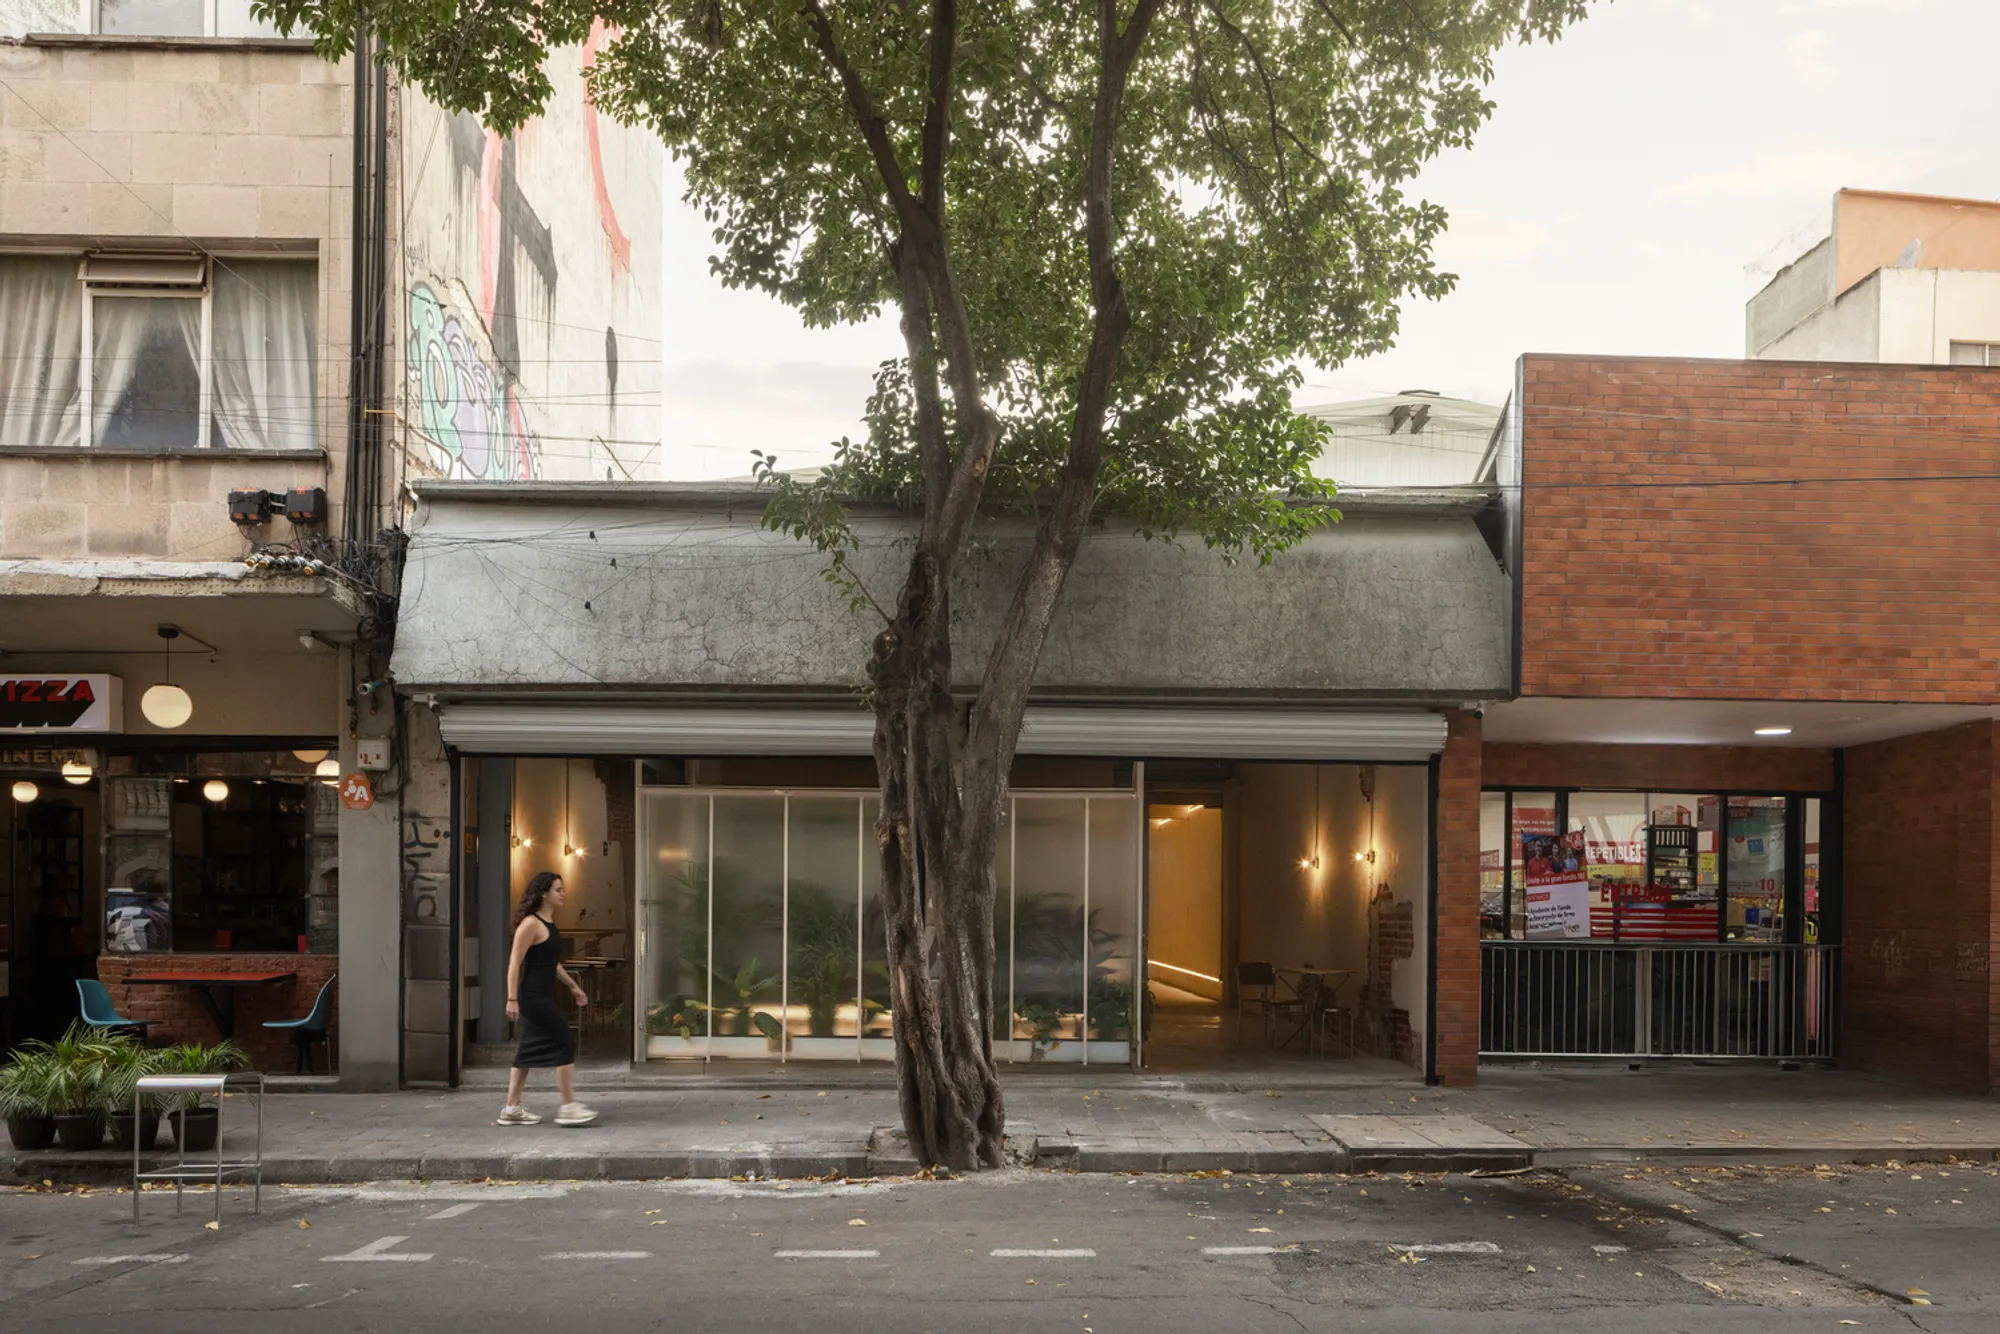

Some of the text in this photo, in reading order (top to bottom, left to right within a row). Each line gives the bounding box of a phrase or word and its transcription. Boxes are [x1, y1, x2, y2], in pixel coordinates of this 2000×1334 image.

[0, 680, 95, 702] IZZA
[1585, 844, 1641, 863] REPETIBLES
[1601, 882, 1673, 904] ENTRADA
